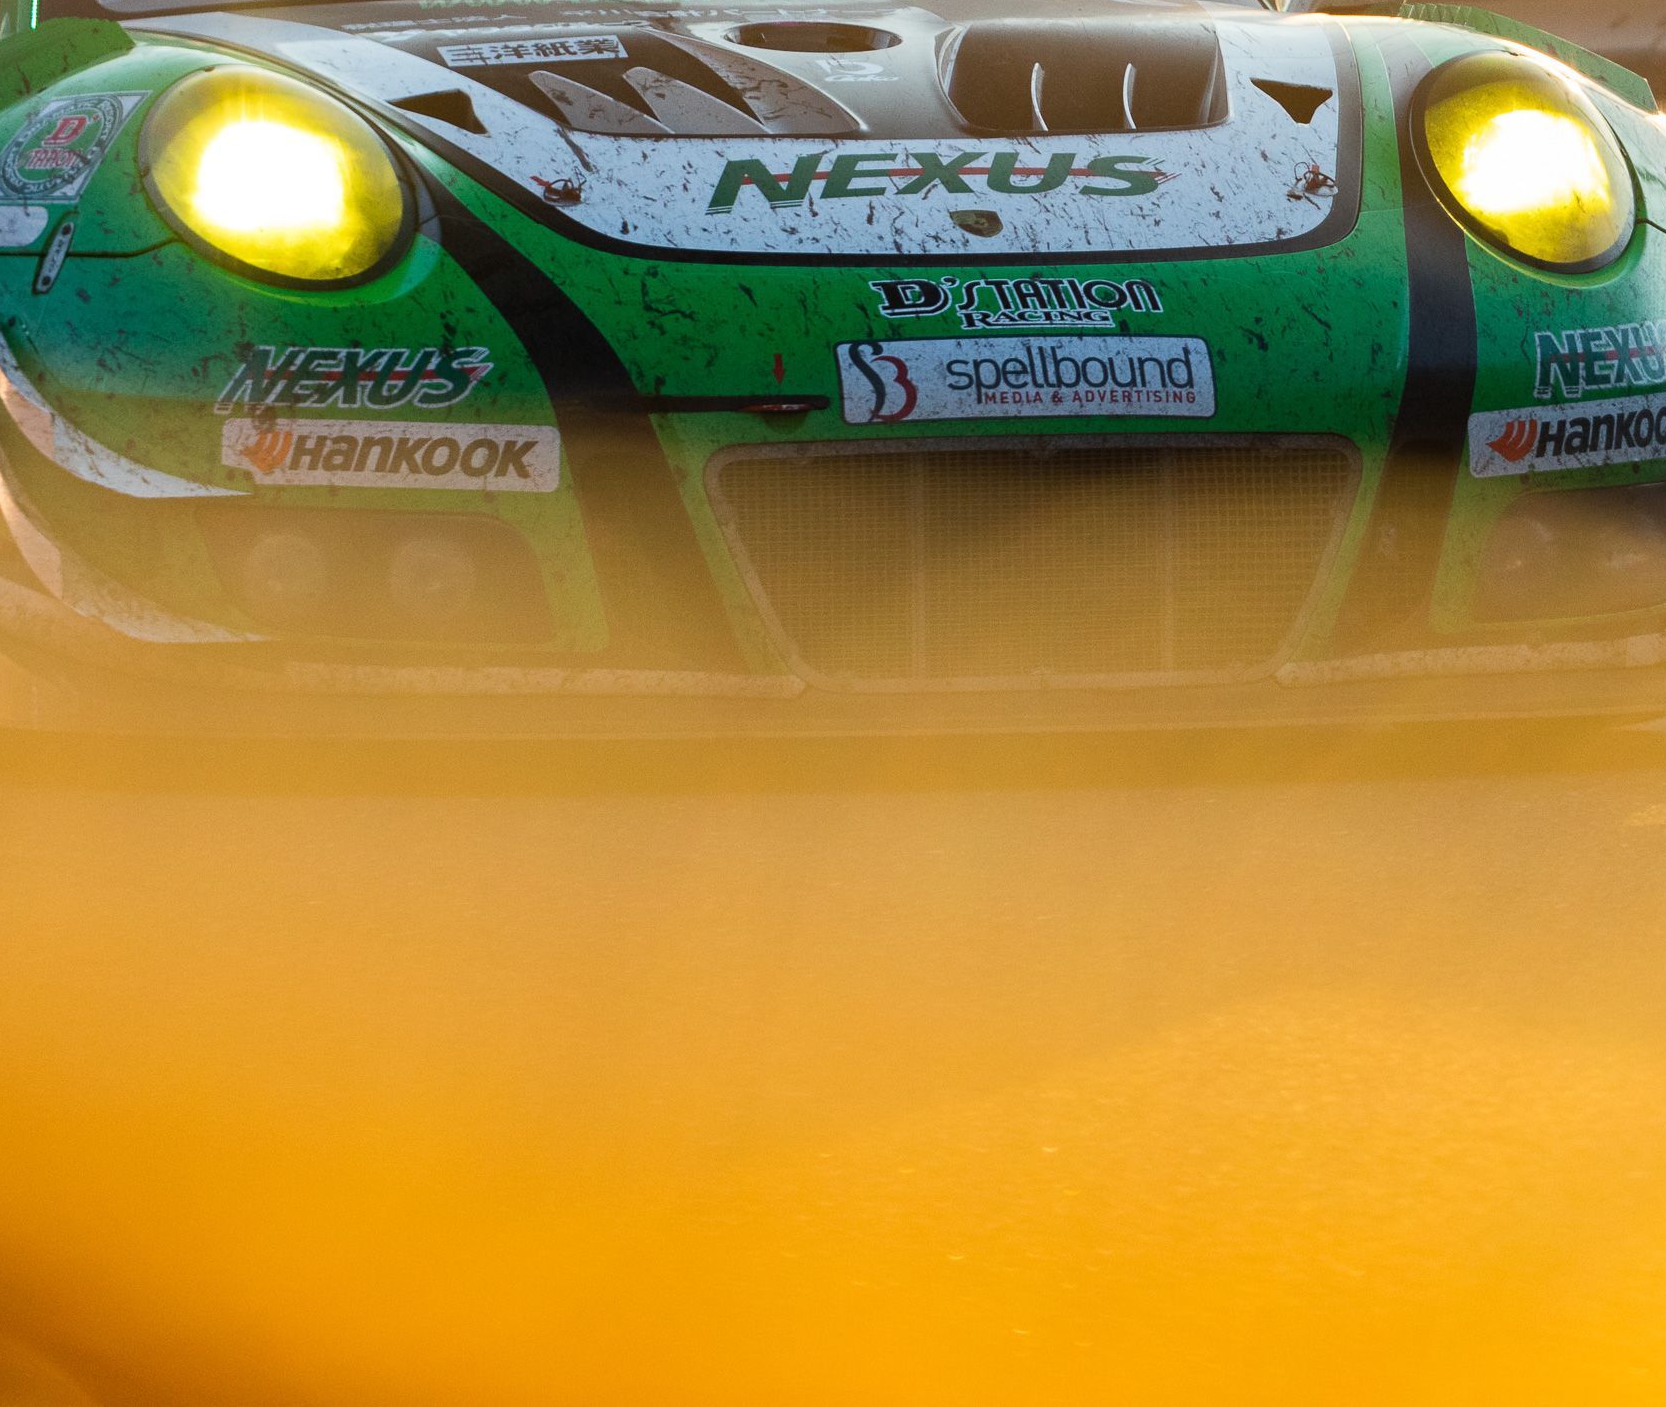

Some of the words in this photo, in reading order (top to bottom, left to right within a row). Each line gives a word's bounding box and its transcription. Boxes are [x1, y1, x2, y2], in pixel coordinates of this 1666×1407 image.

[704, 151, 1181, 214] NEXUS
[958, 308, 1115, 330] RACING
[214, 345, 494, 414] NEXUS
[946, 345, 1195, 404] spellbound
[984, 389, 1044, 404] MEDIA
[1051, 390, 1063, 403] &
[1073, 389, 1197, 404] ADVERTISING
